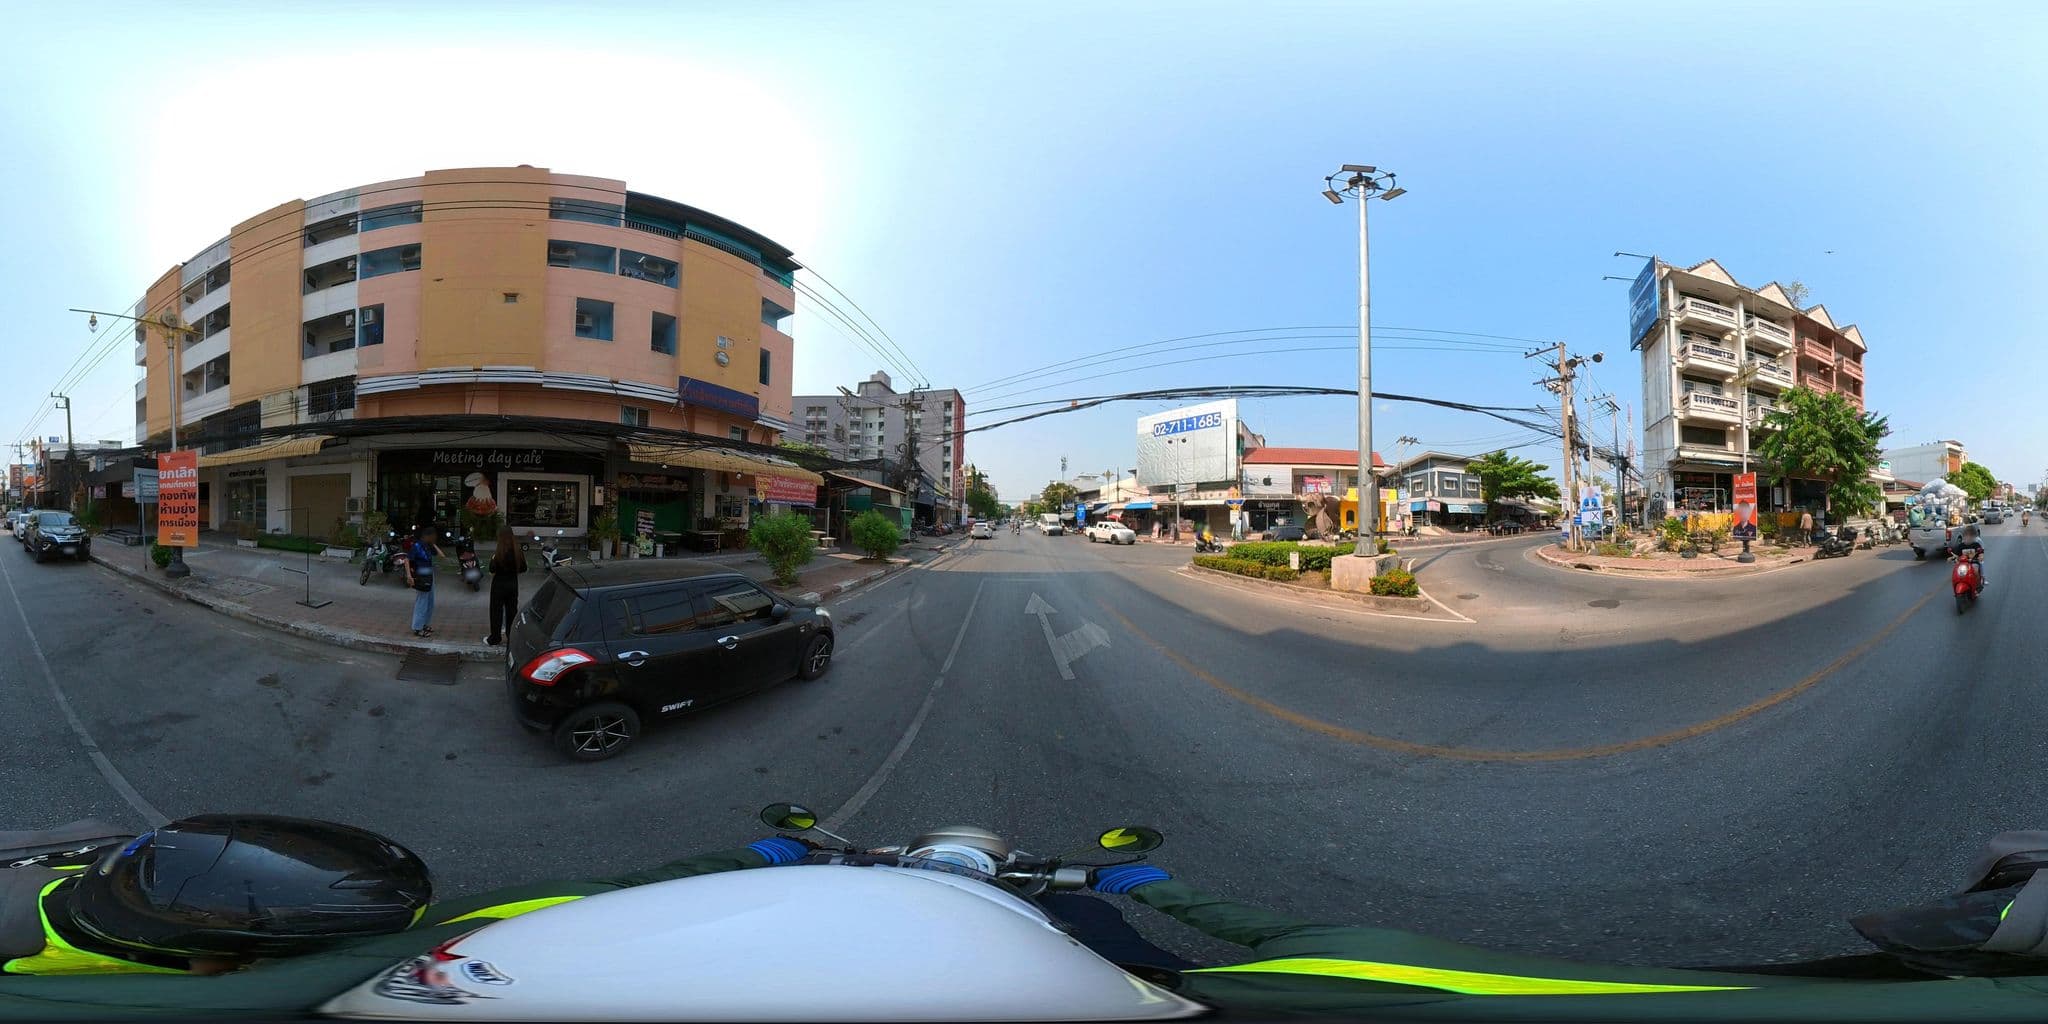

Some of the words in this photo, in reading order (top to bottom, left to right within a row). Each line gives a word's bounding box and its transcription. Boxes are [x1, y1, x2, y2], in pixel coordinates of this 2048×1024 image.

[1154, 414, 1221, 436] 02-711-1685
[433, 449, 483, 468] Meeting
[488, 449, 512, 469] day
[159, 466, 197, 480] ยกเลิก
[160, 489, 196, 500] กองทัพ
[160, 502, 196, 517] ห้ามยุ่ง
[160, 517, 197, 527] การเมือง
[661, 699, 694, 713] SWIFT
[468, 962, 506, 982] INDEX
